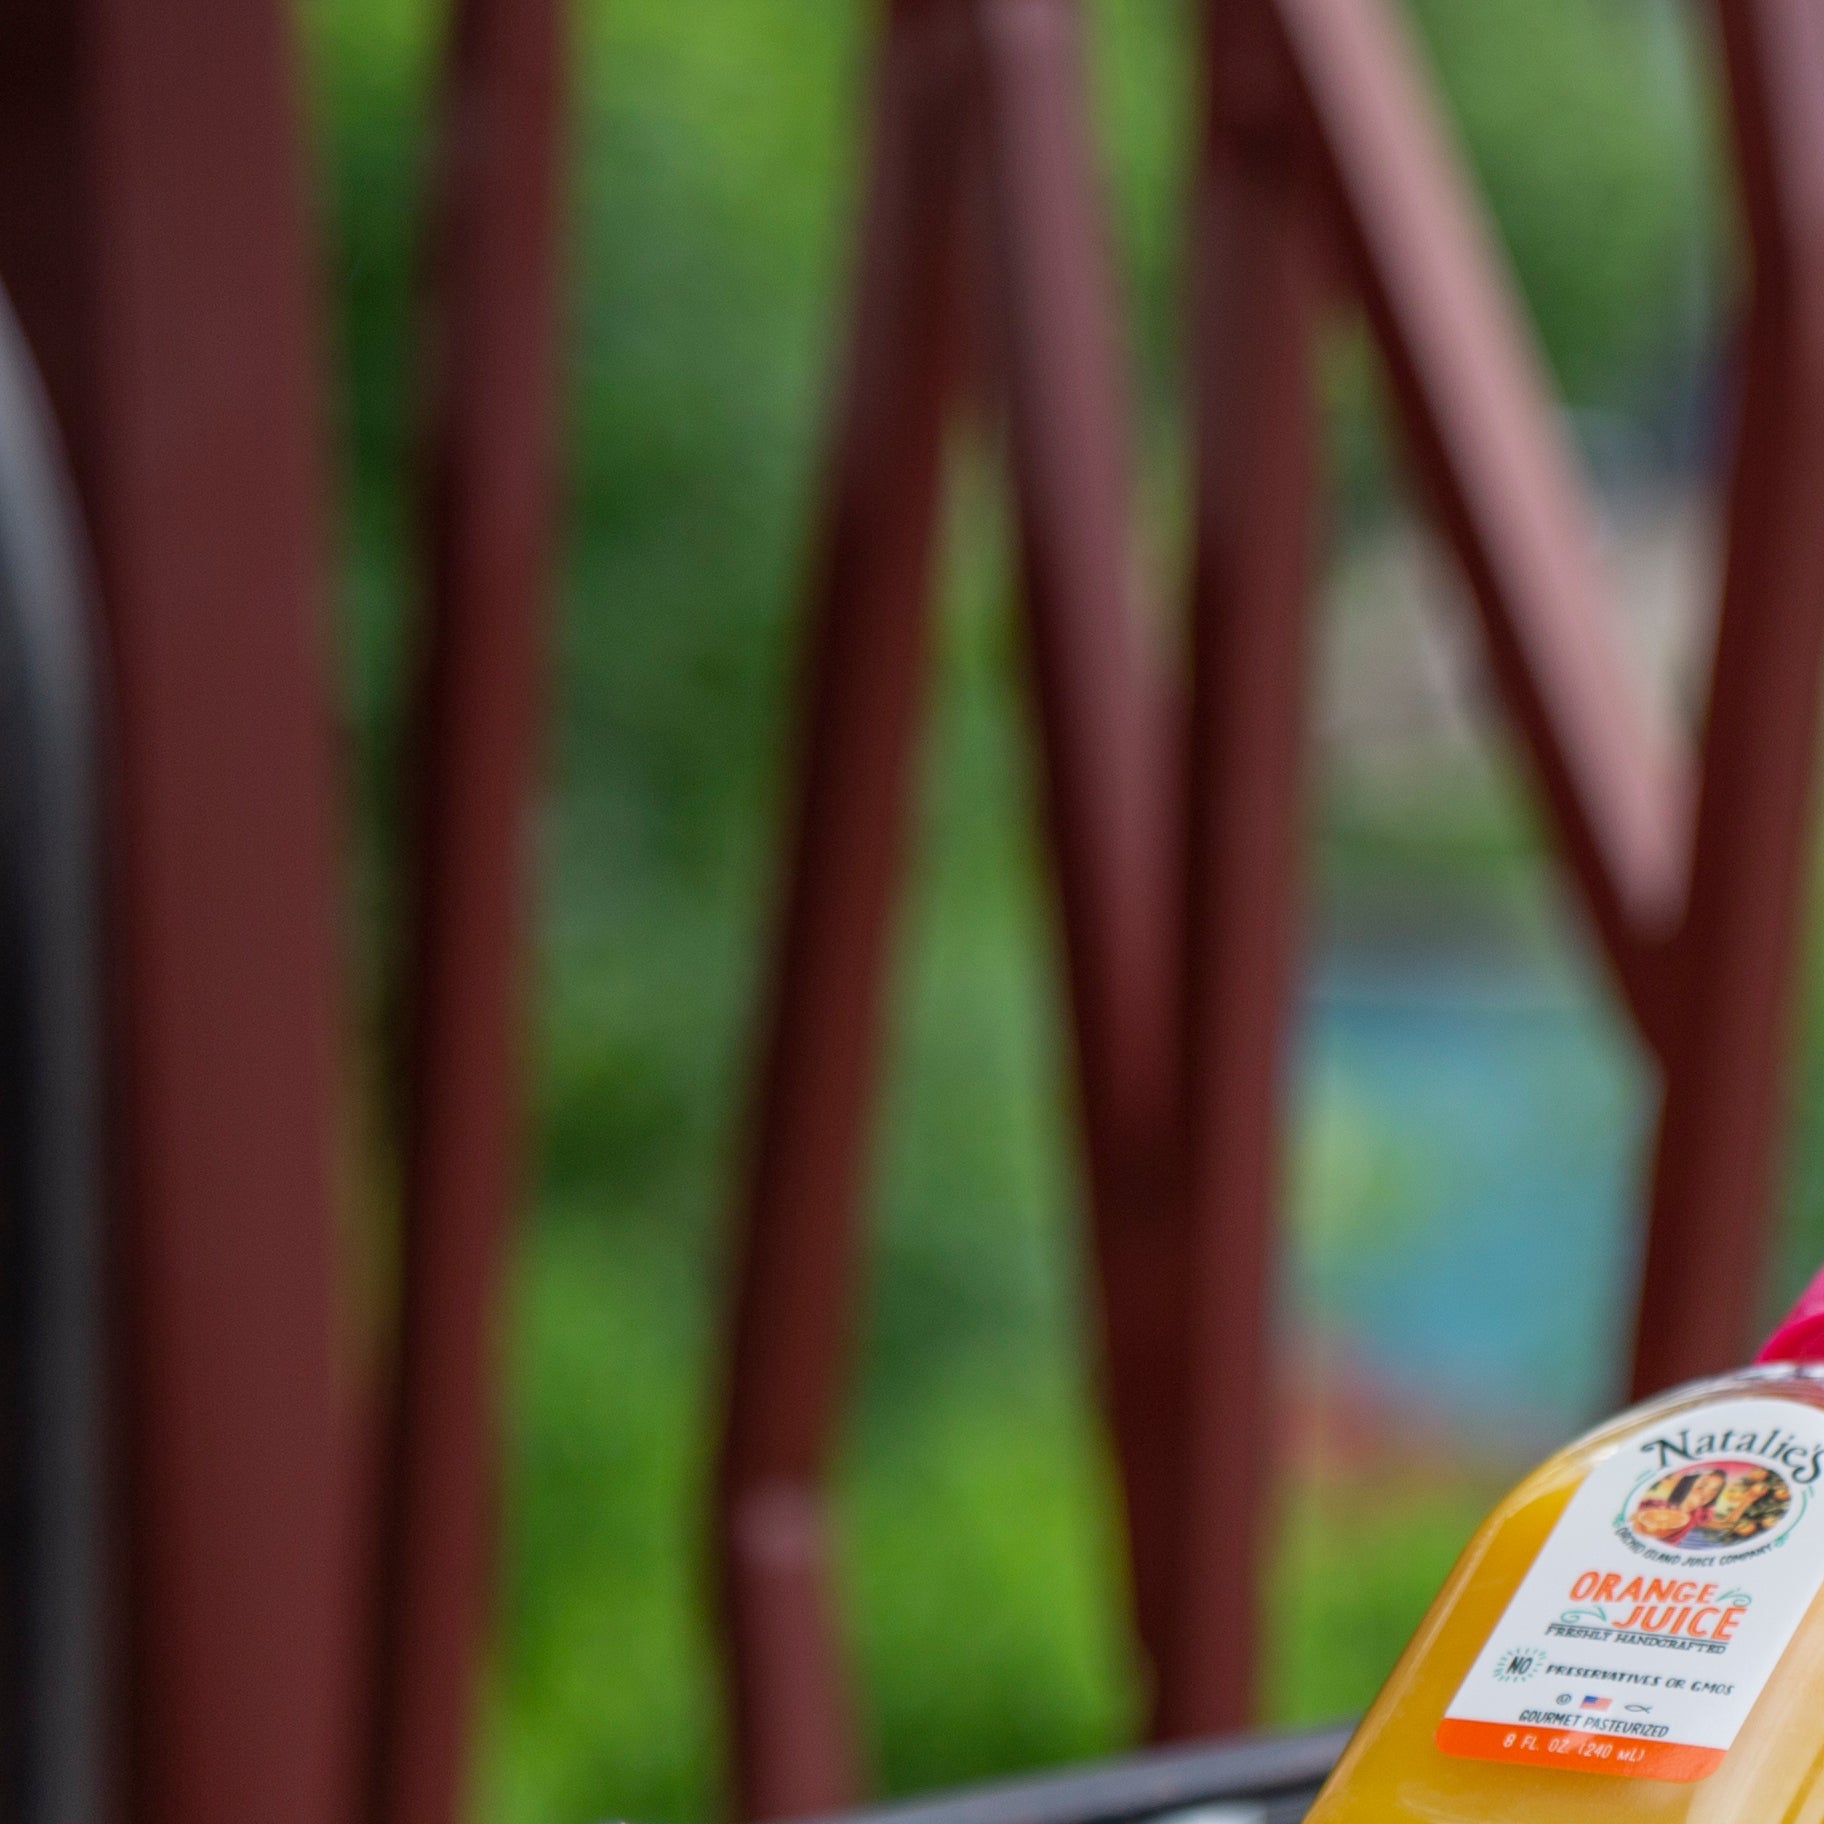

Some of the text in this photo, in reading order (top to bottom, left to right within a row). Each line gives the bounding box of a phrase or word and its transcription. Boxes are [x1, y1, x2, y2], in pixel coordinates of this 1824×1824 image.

[1615, 1526, 1774, 1567] ORCHID ISLAND JUICE COMPANY
[1569, 1570, 1719, 1605] ORANGE
[1544, 1625, 1728, 1655] FRESHLY HANDCRAFTED
[1611, 1605, 1748, 1641] JUICE
[1506, 1655, 1534, 1675] NO
[1545, 1663, 1663, 1687] PRESERVATIVES
[1664, 1678, 1687, 1690] OR
[1518, 1708, 1670, 1739] GOURMET PASTEURIZED
[1502, 1732, 1517, 1748] 8
[1577, 1741, 1614, 1758] (240
